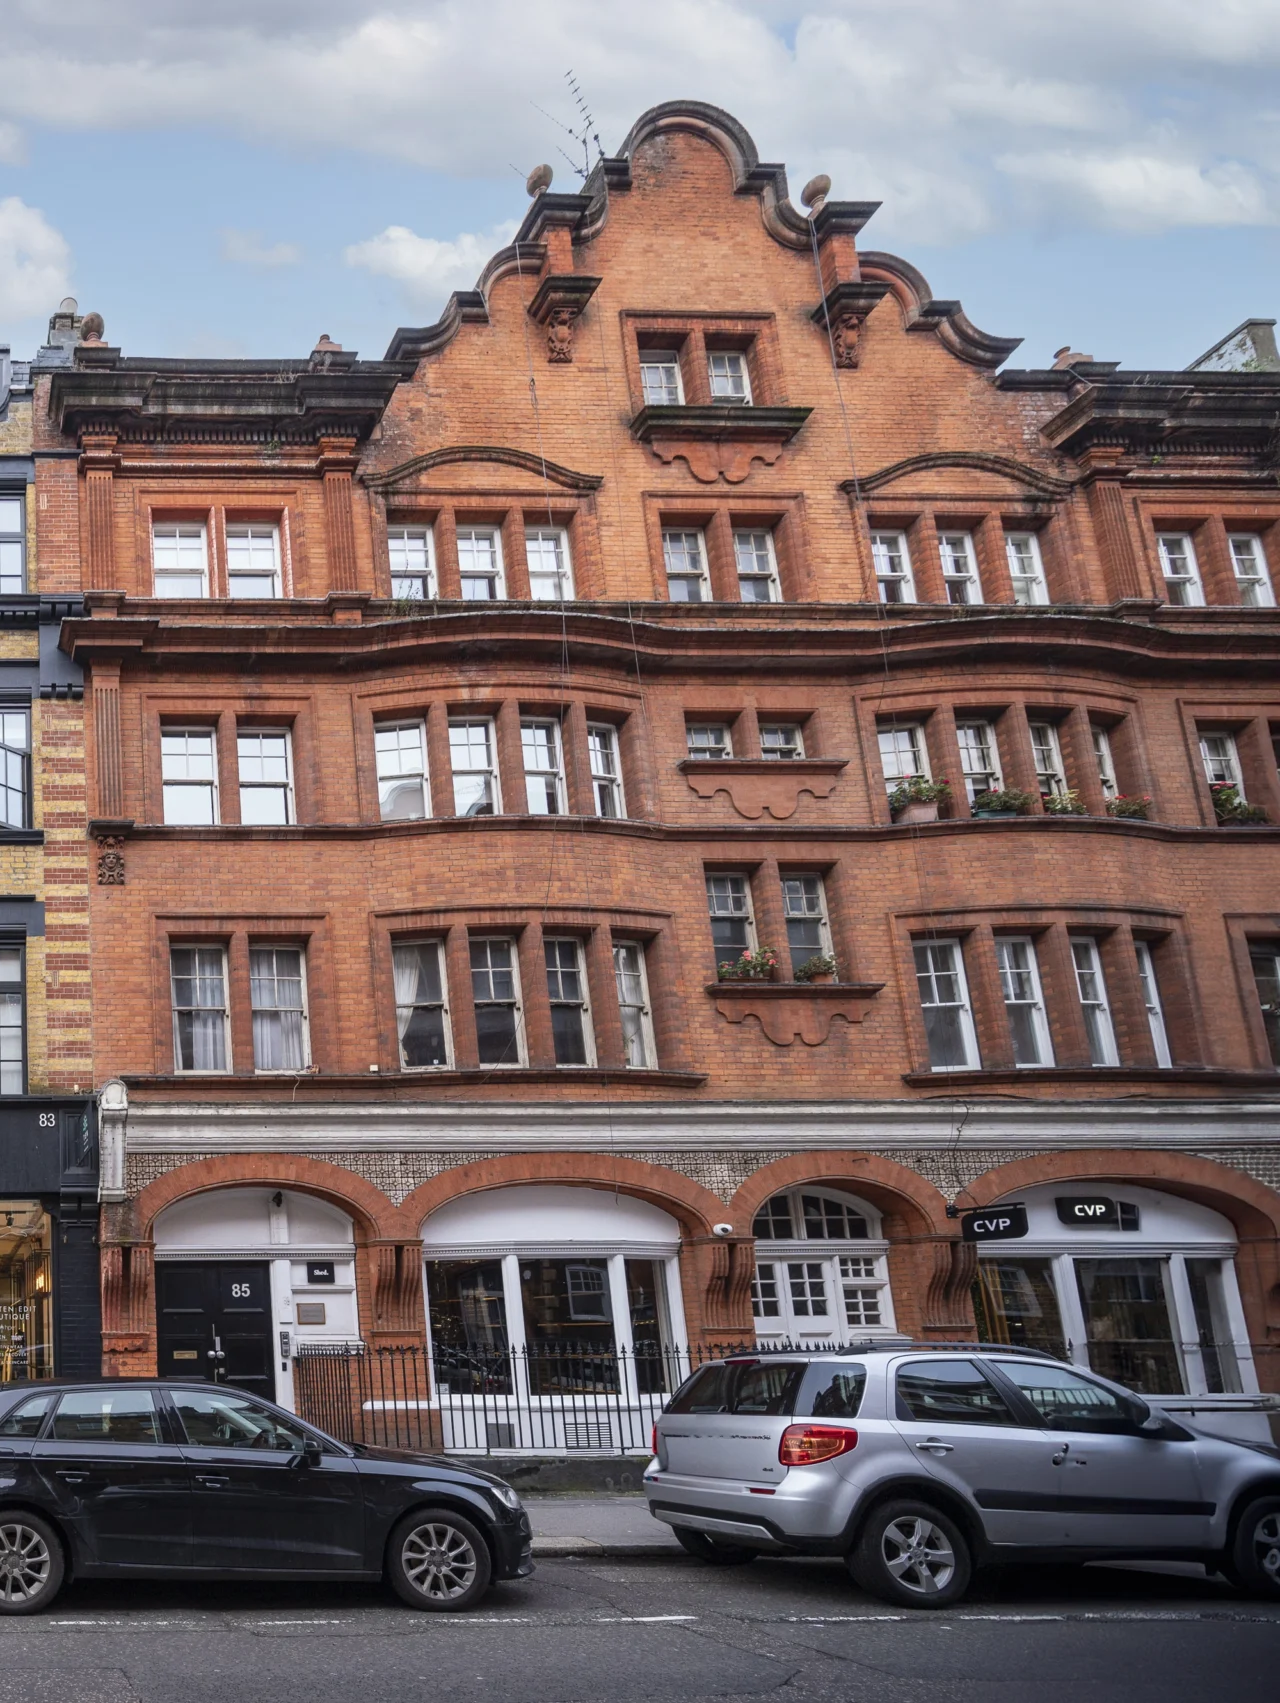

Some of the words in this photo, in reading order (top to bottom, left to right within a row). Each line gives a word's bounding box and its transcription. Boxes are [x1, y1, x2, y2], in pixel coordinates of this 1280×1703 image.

[39, 1113, 55, 1127] 83
[1074, 1204, 1106, 1216] CVP
[973, 1217, 1011, 1233] CVP
[231, 1283, 251, 1298] 85
